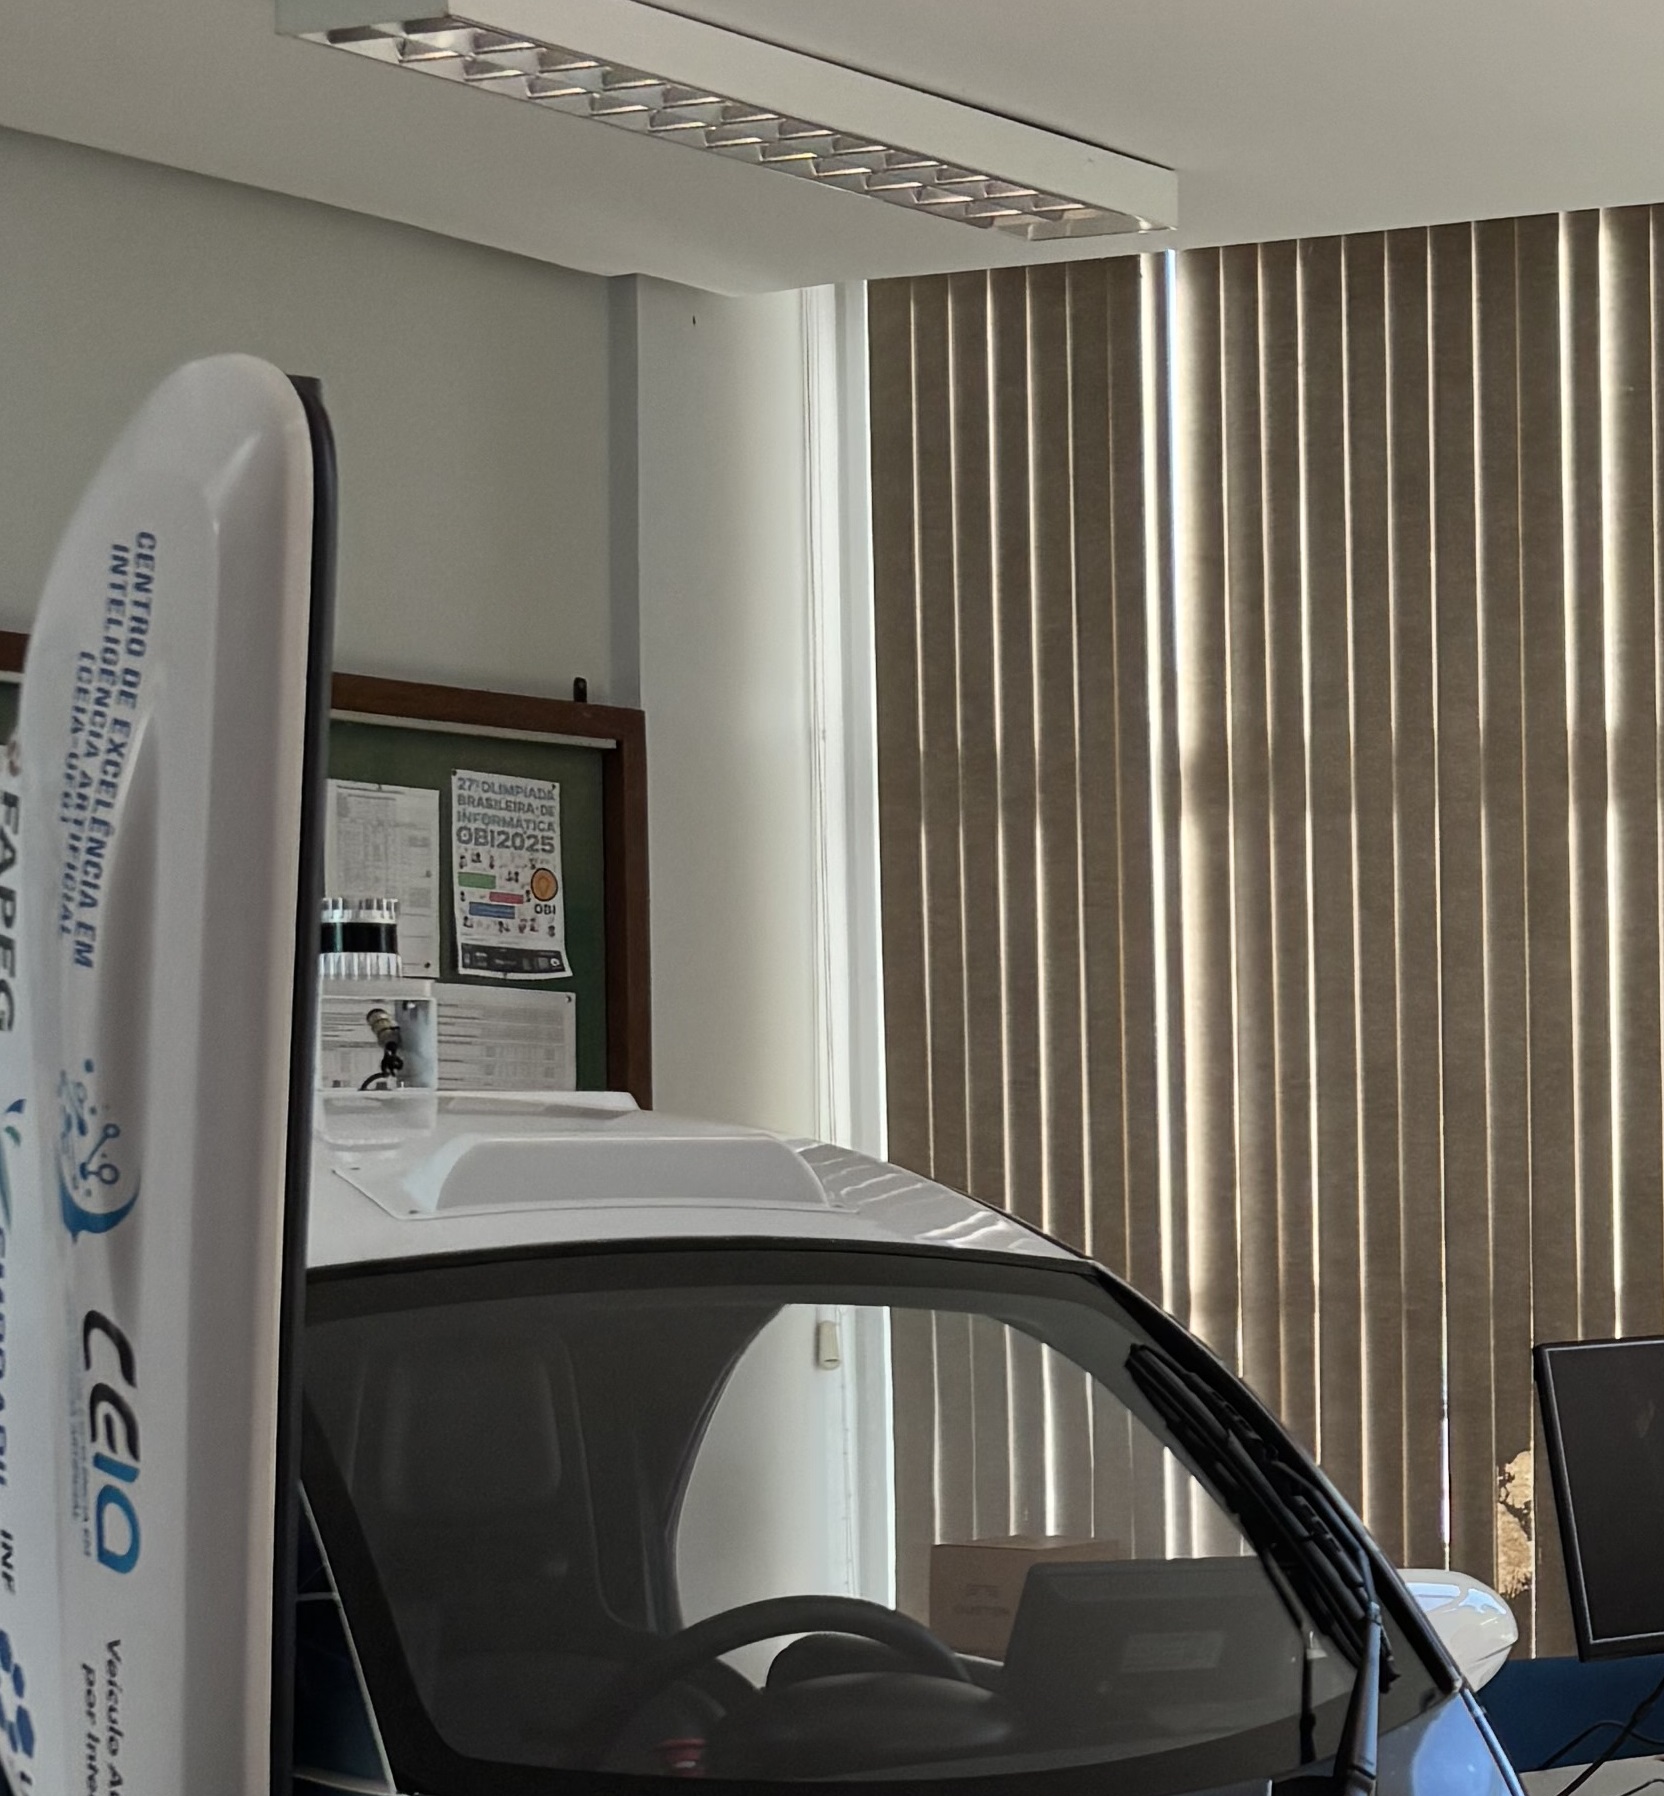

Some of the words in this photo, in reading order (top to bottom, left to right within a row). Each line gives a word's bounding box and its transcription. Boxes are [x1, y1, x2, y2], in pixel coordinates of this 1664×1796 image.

[125, 531, 157, 658] CENTRO
[117, 667, 142, 710] DE
[456, 826, 556, 855] OBI2025
[534, 903, 556, 915] OBI
[73, 920, 97, 969] EM
